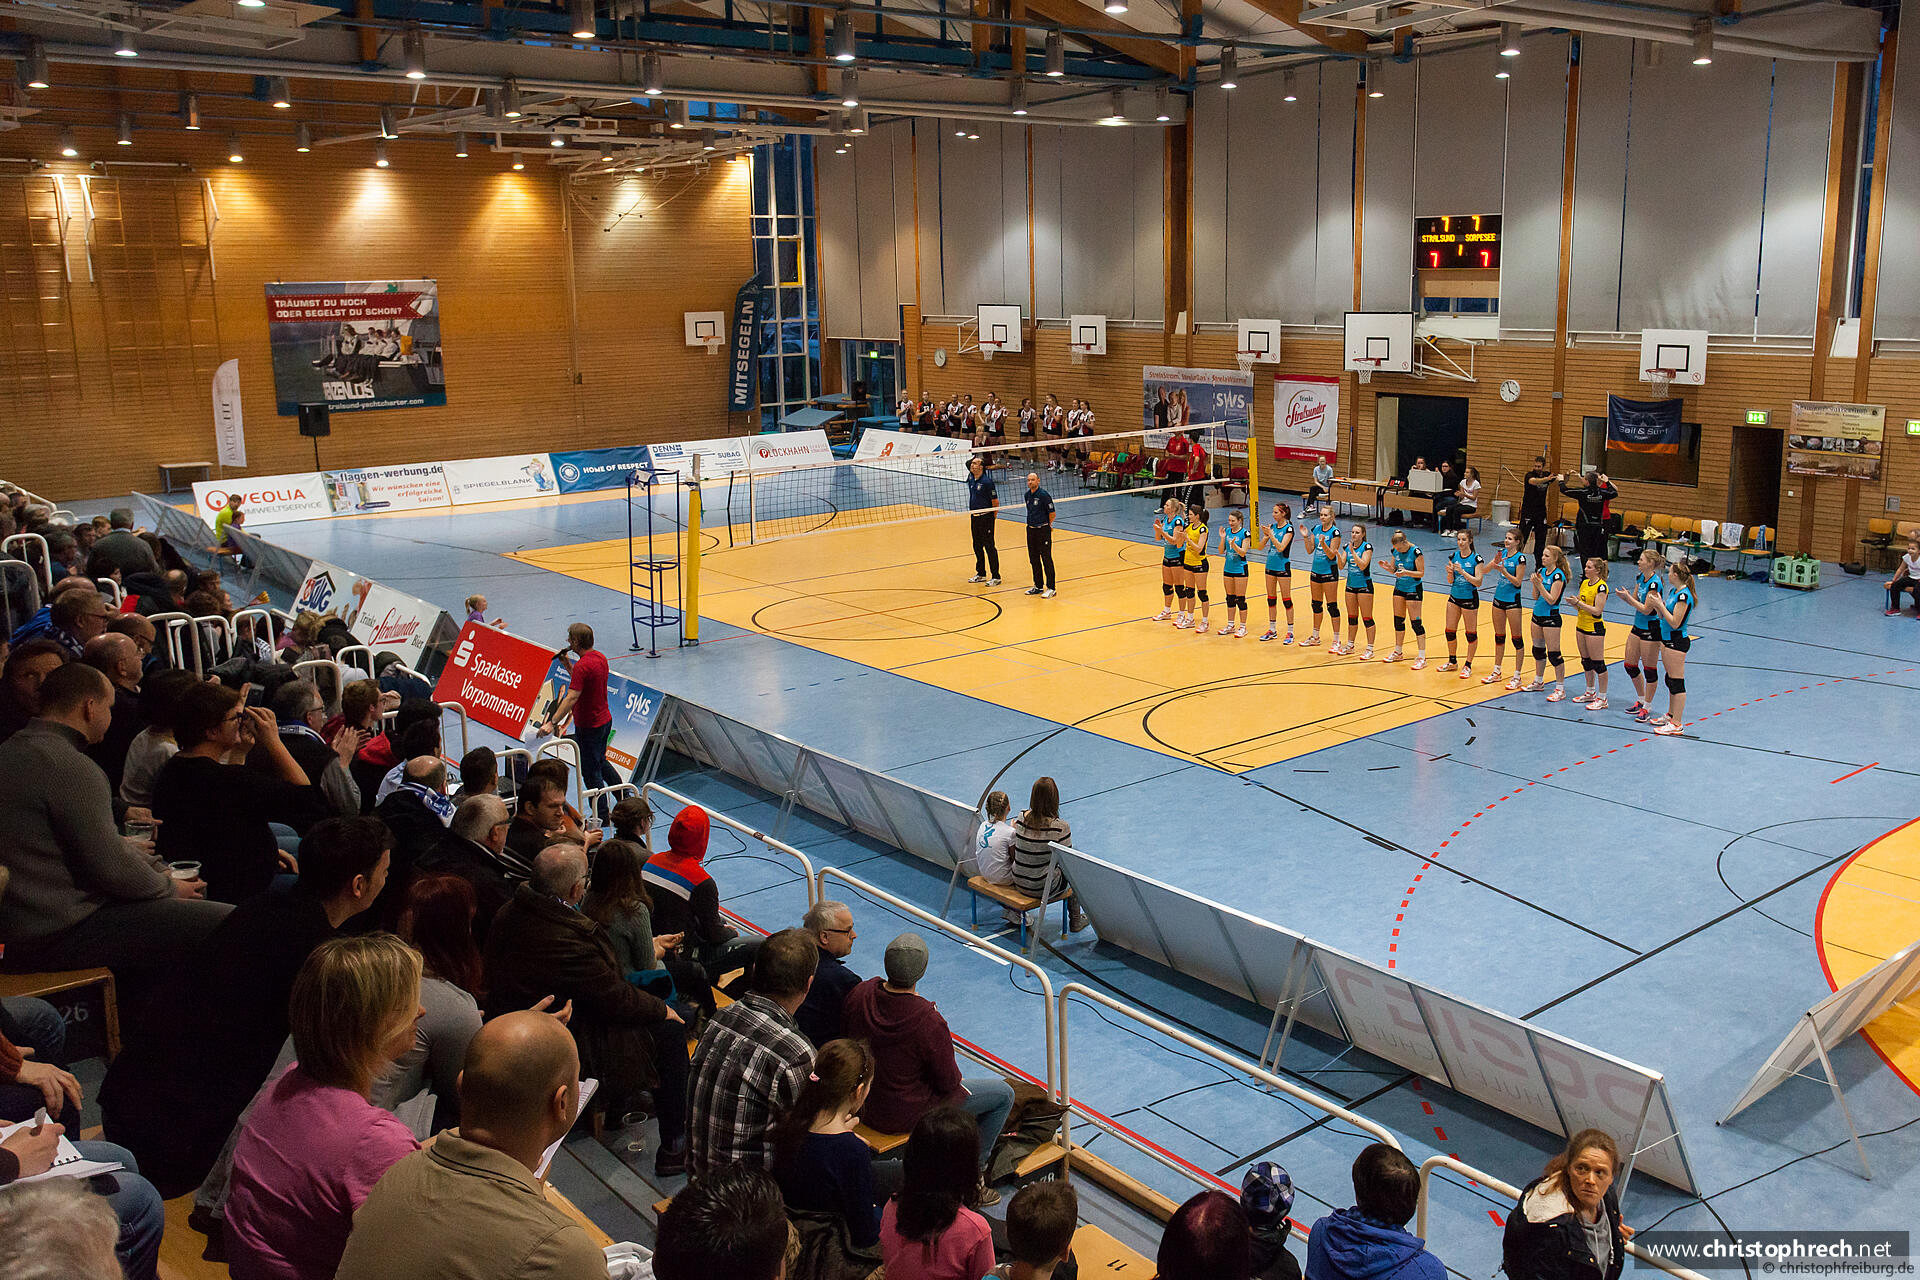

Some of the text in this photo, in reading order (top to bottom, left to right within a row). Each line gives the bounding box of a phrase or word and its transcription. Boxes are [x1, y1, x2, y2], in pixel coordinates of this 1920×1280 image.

[1421, 234, 1456, 243] STRALSUND
[1464, 233, 1497, 242] SORPESEE
[275, 298, 367, 308] TRÄUMST DU NOCH
[276, 310, 302, 318] ODER
[305, 309, 347, 318] SEGELST
[350, 308, 363, 316] DU
[734, 300, 755, 405] MITSEGELN
[1619, 426, 1668, 435] Sail & Surf
[583, 466, 605, 474] HOME
[606, 464, 616, 472] OF
[617, 461, 649, 470] RESPECT
[367, 607, 421, 647] Stralsunder
[410, 634, 425, 650] Bier
[470, 653, 523, 689] Sparkasse
[460, 678, 526, 723] Vorpommern
